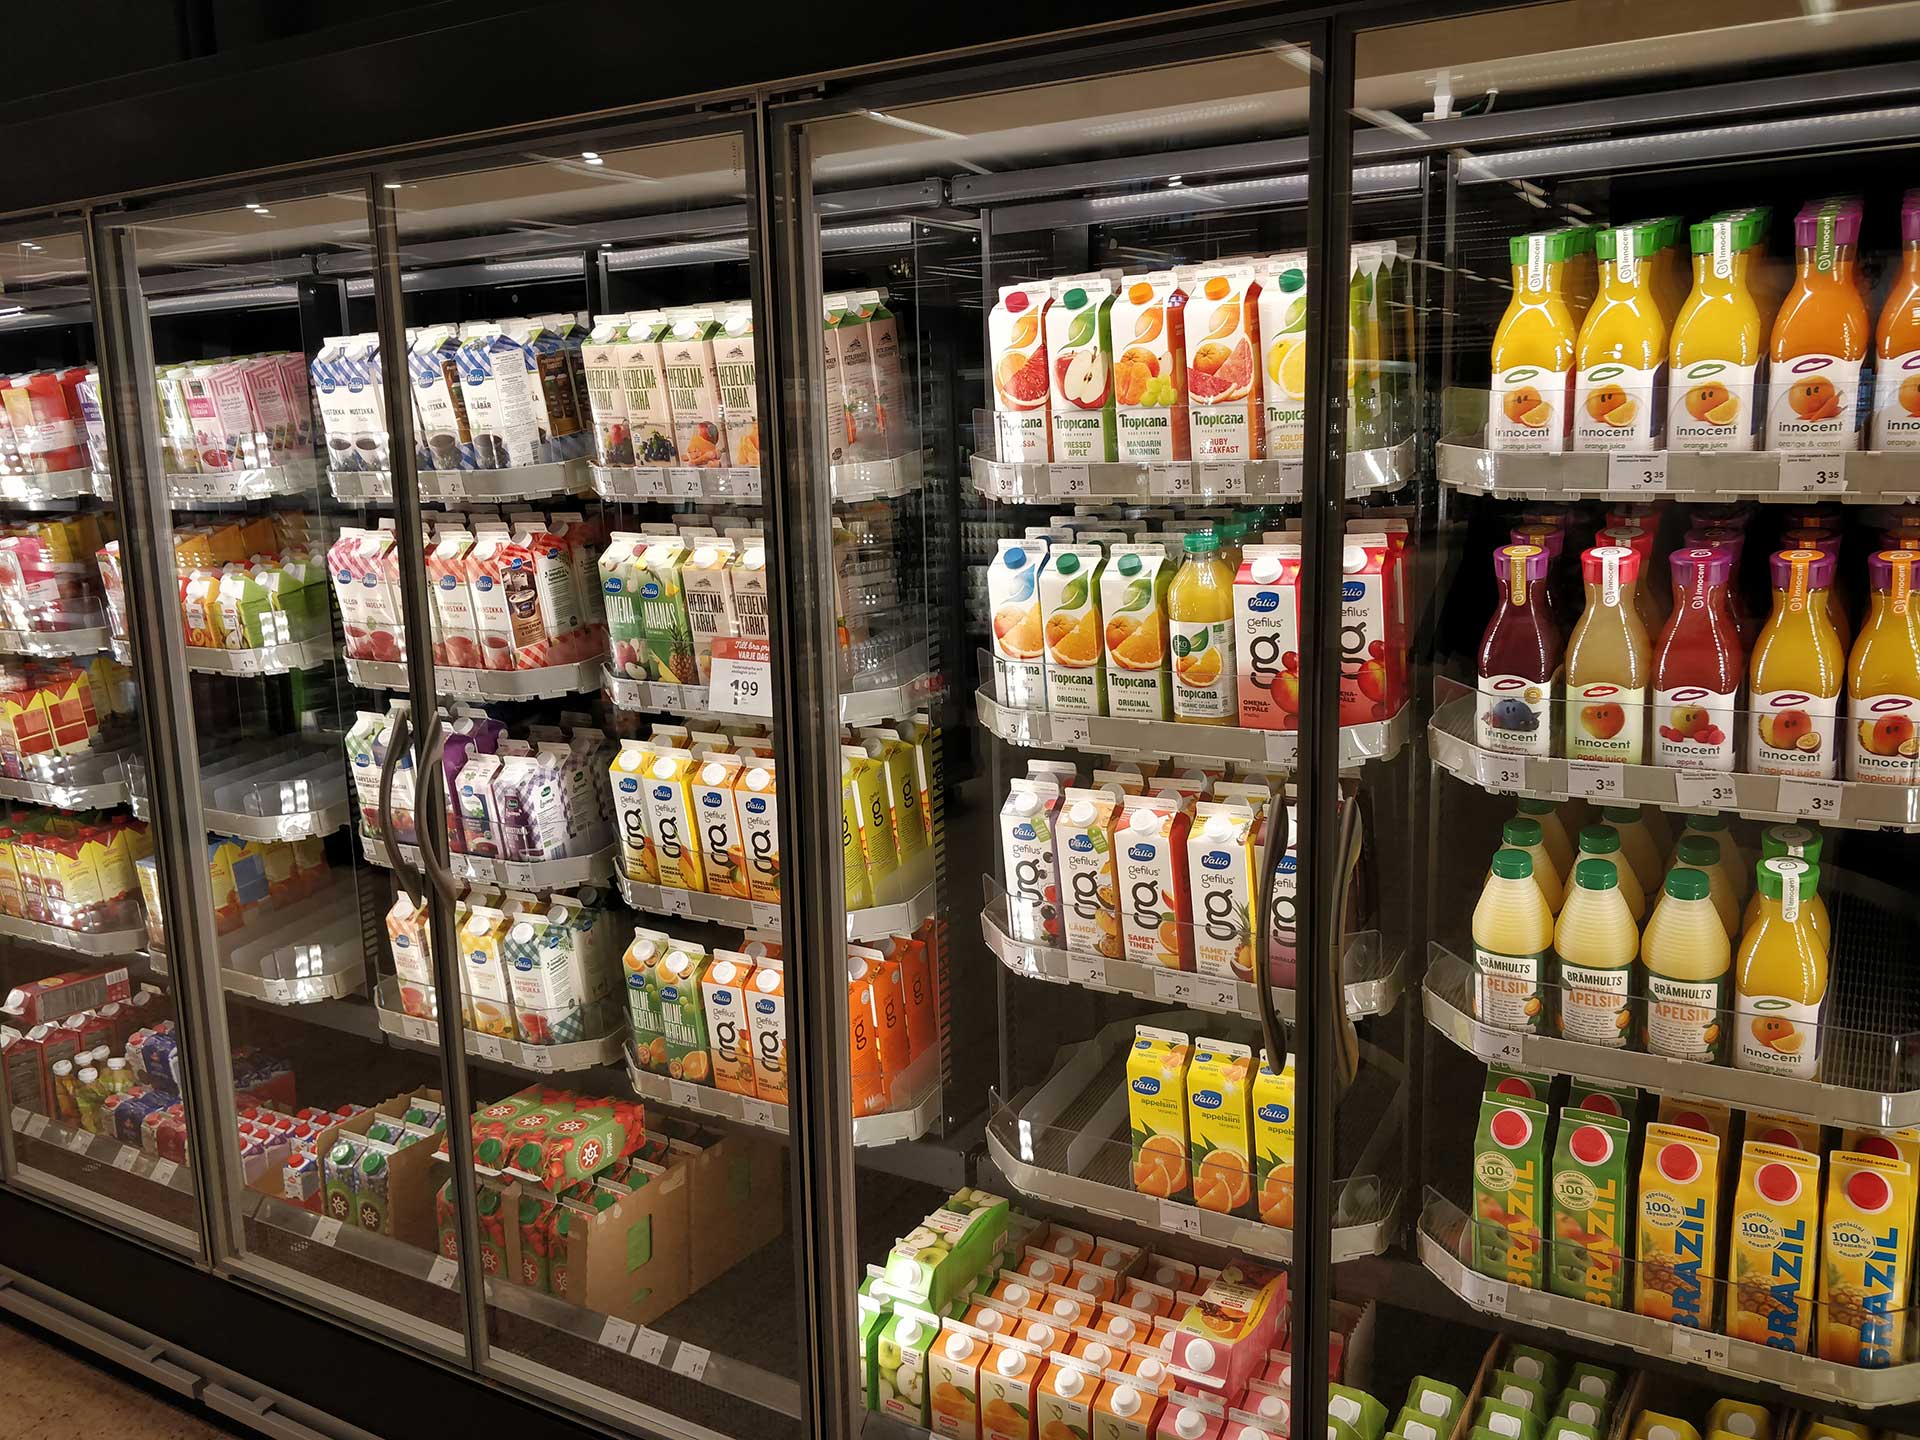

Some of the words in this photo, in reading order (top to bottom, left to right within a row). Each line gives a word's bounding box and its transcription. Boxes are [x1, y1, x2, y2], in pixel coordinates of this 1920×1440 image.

[670, 388, 698, 410] TARHA
[721, 386, 751, 409] TARHA
[1054, 415, 1100, 429] Tropicana
[1118, 414, 1167, 430] Tropicana
[1192, 411, 1244, 426] Tropicana
[1495, 427, 1550, 438] innocent
[1578, 426, 1635, 437] innocent
[1676, 424, 1737, 436] innocent
[1778, 421, 1843, 432] innocent
[1063, 441, 1092, 449] PRESSED
[1126, 440, 1162, 448] MANDARIN
[1525, 442, 1542, 450] juice
[1609, 442, 1626, 450] juice
[1683, 442, 1709, 450] orange
[1710, 441, 1728, 449] juice
[1068, 449, 1088, 457] APPLE
[1249, 596, 1277, 609] Valio
[690, 612, 718, 633] TARHA
[739, 615, 767, 636] TARHA
[1247, 616, 1284, 635] gefilus
[1048, 670, 1093, 686] Tropicana
[1109, 673, 1157, 689] Tropicana
[1057, 695, 1088, 704] ORIGINAL
[1176, 686, 1218, 700] Tropicana
[1118, 699, 1150, 708] ORIGINAL
[1243, 699, 1271, 707] OMENA-
[1485, 728, 1538, 742] innocent
[1574, 736, 1631, 749] innocent
[1662, 742, 1720, 755] innocent
[1759, 748, 1820, 762] innocent
[1676, 759, 1696, 767] apple
[619, 780, 636, 790] Valio
[703, 795, 721, 805] Valio
[746, 800, 765, 811] Valio
[1013, 827, 1036, 838] Valio
[1070, 838, 1093, 849] Valio
[1130, 847, 1154, 859] Valio
[1203, 854, 1229, 867] Valio
[1128, 865, 1160, 880] gefilus
[1201, 873, 1235, 888] gefilus
[1128, 933, 1159, 945] SAMET-
[1128, 941, 1154, 951] TINEN
[1200, 944, 1232, 956] SAMET-
[1200, 951, 1226, 962] TINEN
[1479, 956, 1531, 974] BRÄMHULTS
[1567, 970, 1622, 987] BRÄMHULTS
[1654, 983, 1712, 1000] BRÄMHULTS
[1569, 991, 1621, 1008] APELSIN
[1654, 1005, 1709, 1022] APELSIN
[1743, 1044, 1802, 1063] innocent
[1133, 1080, 1158, 1093] Valio
[1141, 1097, 1178, 1110] appelsiini
[1194, 1093, 1220, 1107] Valio
[1201, 1111, 1241, 1124] appelsiini
[1259, 1107, 1287, 1121] Valio
[1657, 1127, 1709, 1144] Appelsiini-ananas
[1753, 1147, 1808, 1163] Appelsiini-ananas
[1841, 1154, 1898, 1169] Appelsiini-ananas
[1506, 1160, 1534, 1288] BRAZIL
[1584, 1179, 1616, 1308] BRAZIL
[1671, 1197, 1705, 1330] BRAZIL
[1766, 1219, 1806, 1353] BRAZIL
[1858, 1227, 1898, 1370] BRAZIL
